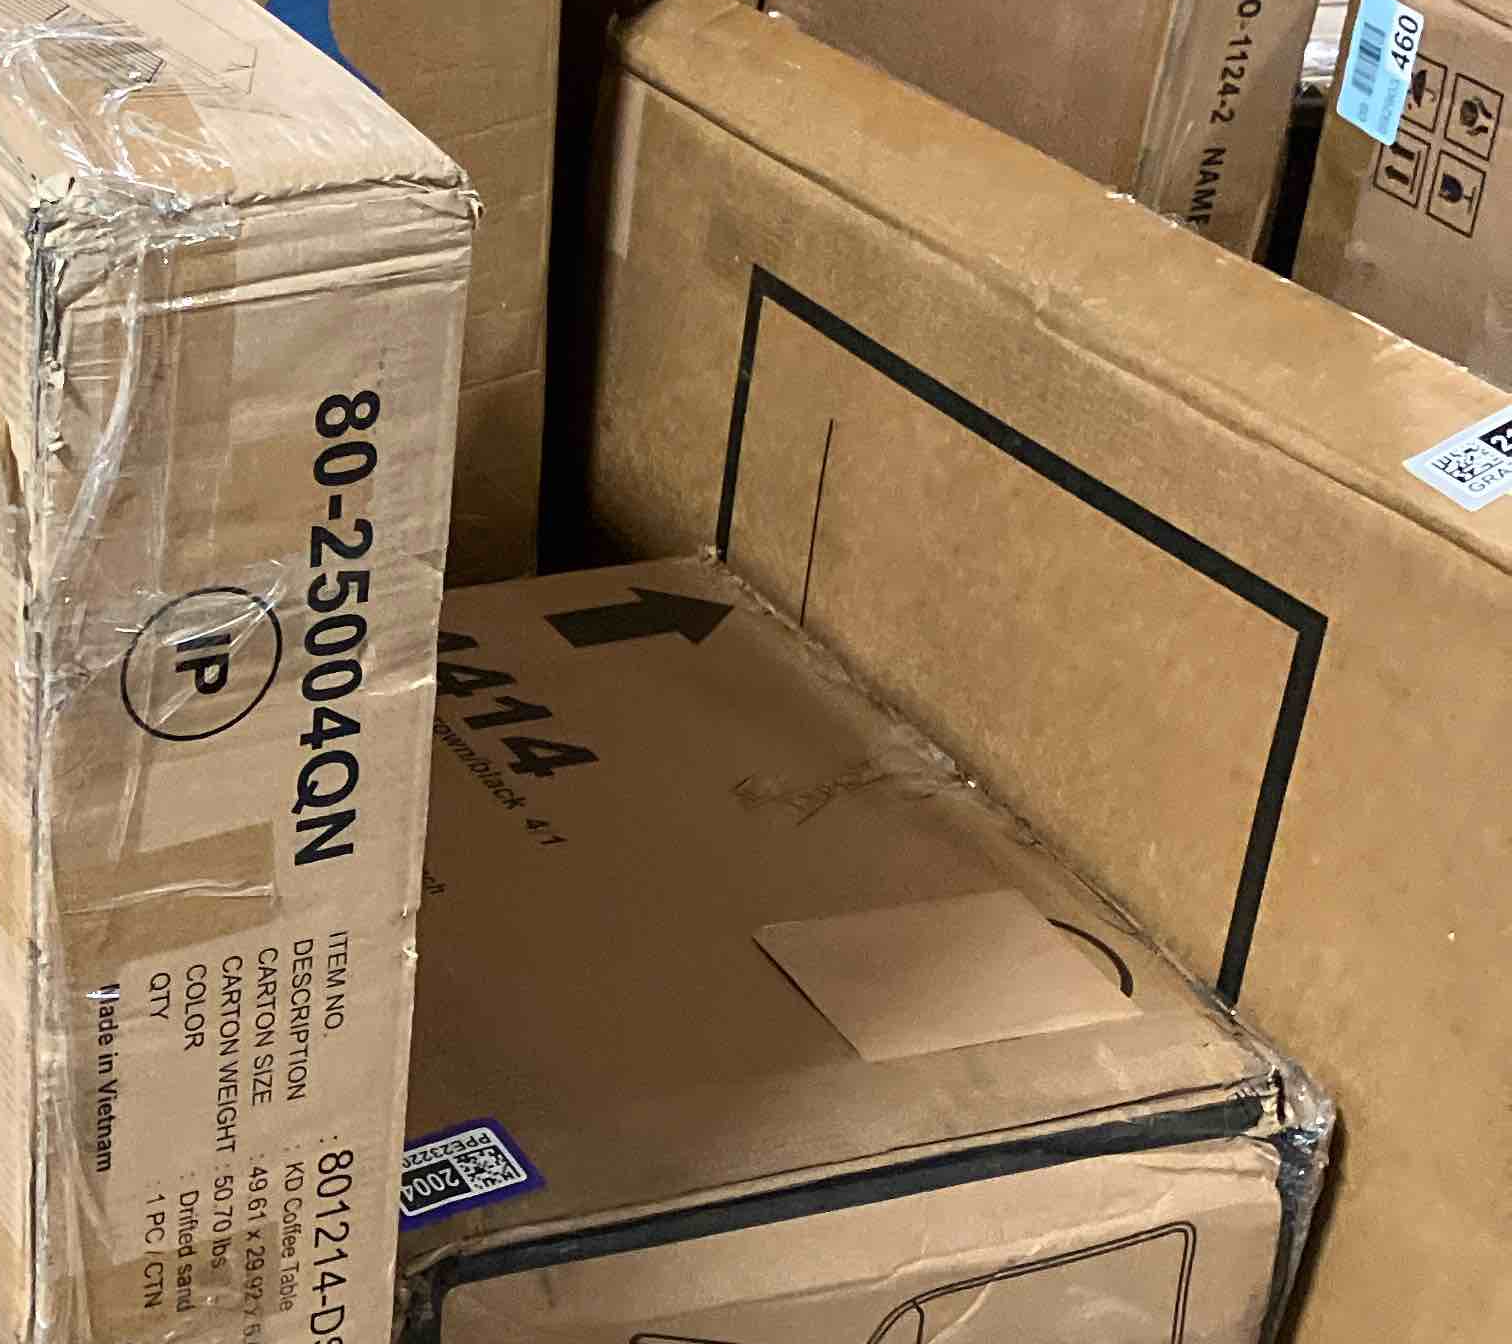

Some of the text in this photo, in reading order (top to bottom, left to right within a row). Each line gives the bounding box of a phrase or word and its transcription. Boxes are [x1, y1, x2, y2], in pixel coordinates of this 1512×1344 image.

[1389, 13, 1420, 69] 460
[290, 388, 382, 867] 80-25004QN
[149, 972, 172, 1021] QTY
[326, 930, 349, 989] ITEM
[183, 963, 208, 1052] COLOR
[251, 947, 279, 1106] CARTON SIZE
[286, 938, 314, 1102] DESCRIPTION
[97, 1052, 120, 1075] in
[215, 955, 244, 1153] CARTON WEIGHT
[95, 1079, 119, 1173] Vietnam
[400, 1167, 461, 1203] 2004
[144, 1211, 166, 1245] PC
[175, 1189, 200, 1313] Drifted sand
[210, 1236, 233, 1270] lbs
[279, 1161, 305, 1313] KD Coffee Table
[143, 1261, 165, 1309] CTN
